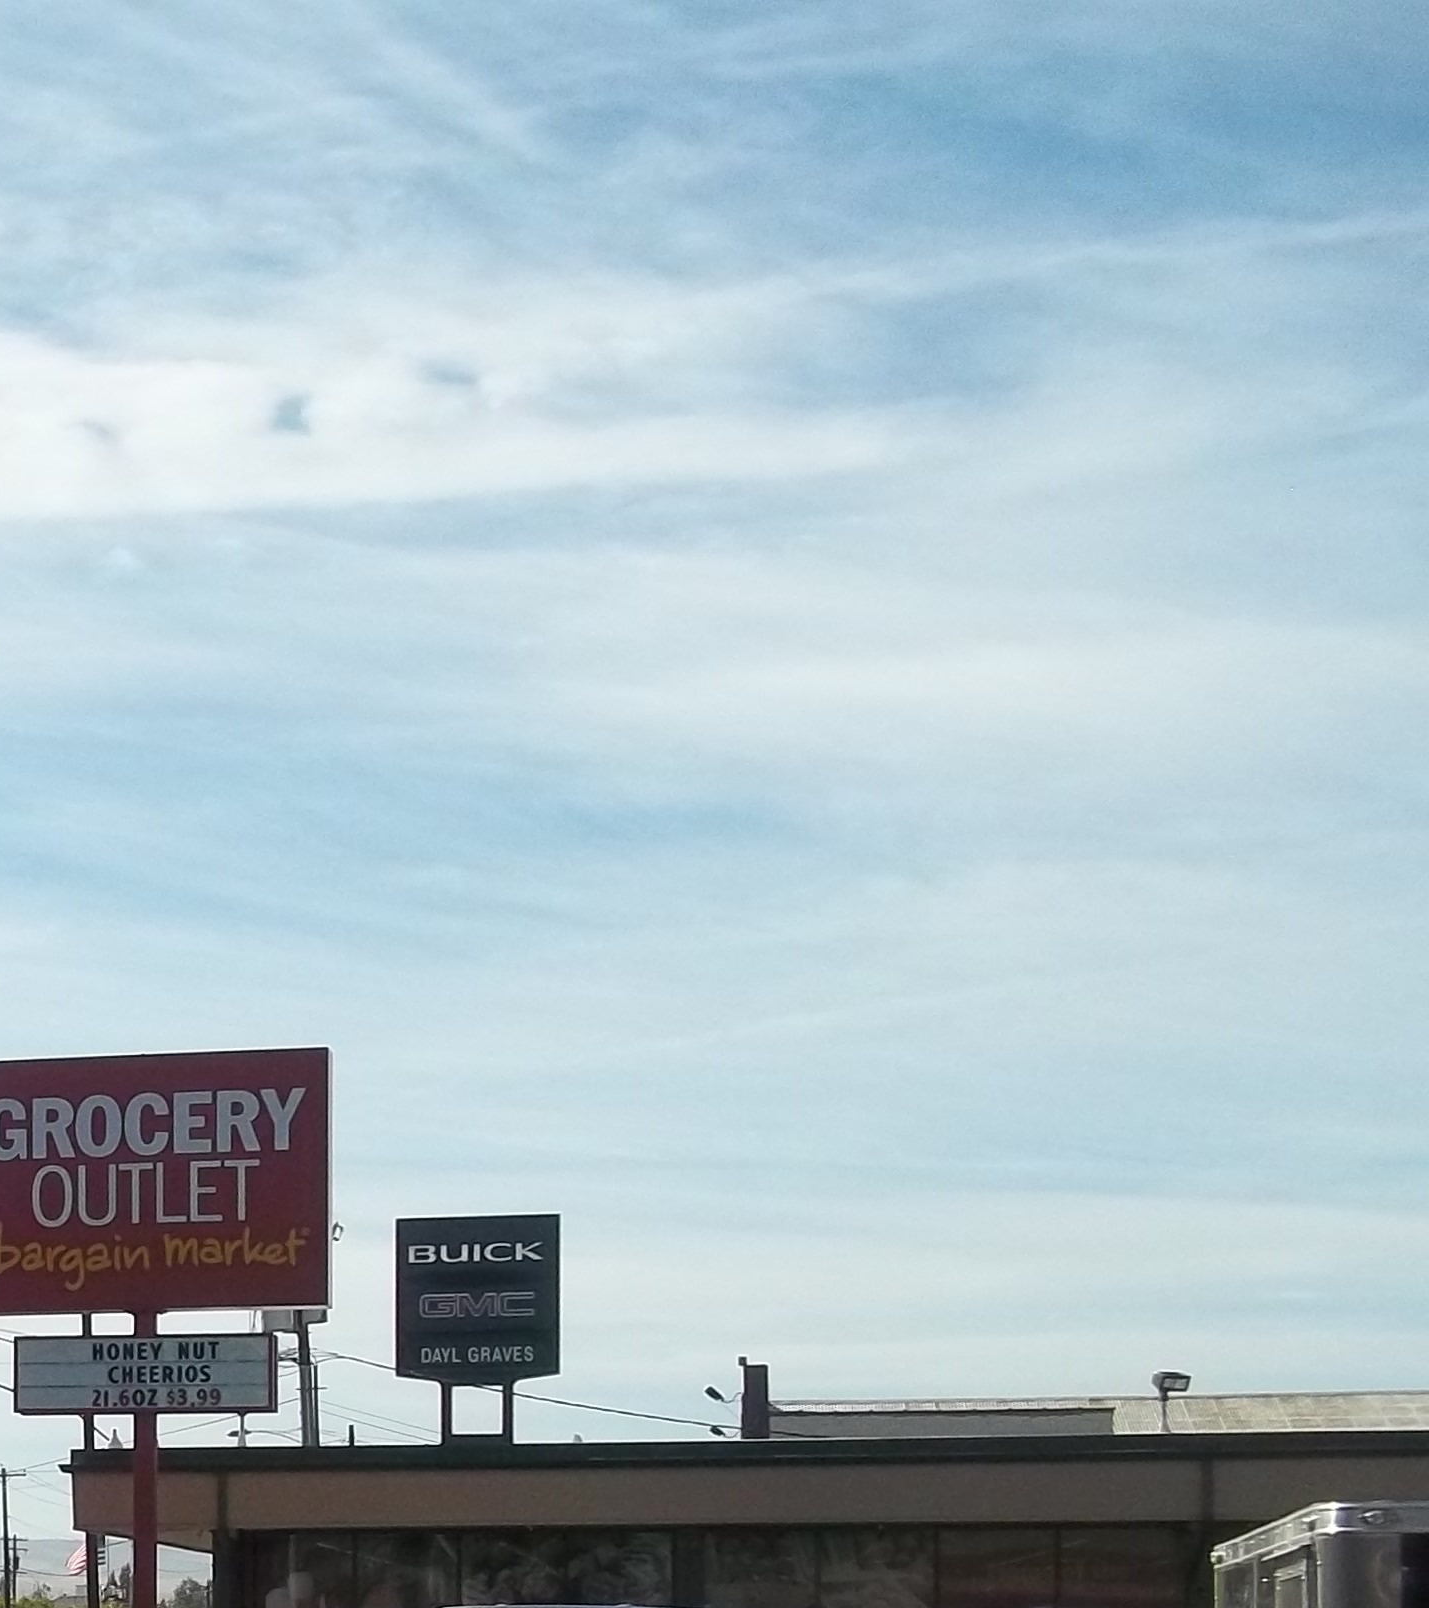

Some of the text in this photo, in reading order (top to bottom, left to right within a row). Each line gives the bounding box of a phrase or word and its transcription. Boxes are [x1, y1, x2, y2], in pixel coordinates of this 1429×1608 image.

[32, 1159, 260, 1228] OUTLET
[165, 1226, 306, 1267] market
[408, 1241, 543, 1264] BUICK
[419, 1291, 535, 1318] GMC
[92, 1341, 220, 1361] HONEY NUT
[420, 1345, 534, 1364] DAYL GRAVES
[108, 1365, 211, 1384] CHEERIOS
